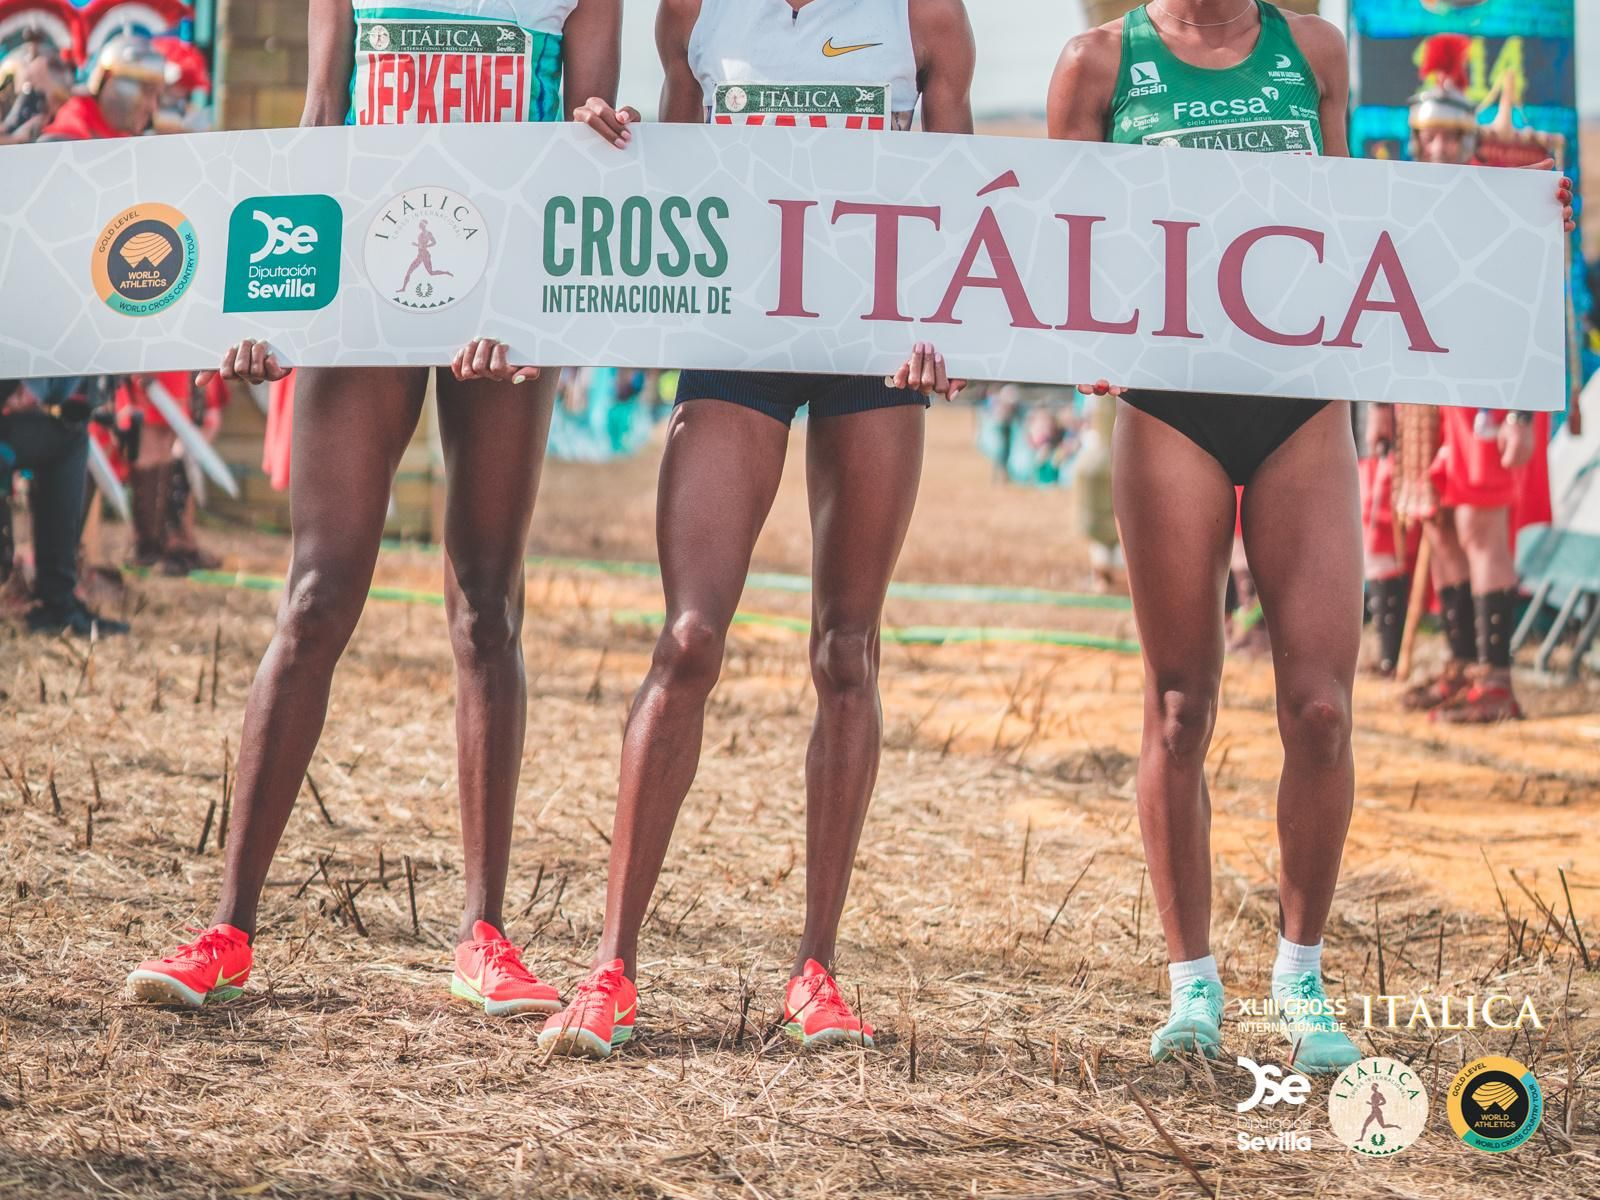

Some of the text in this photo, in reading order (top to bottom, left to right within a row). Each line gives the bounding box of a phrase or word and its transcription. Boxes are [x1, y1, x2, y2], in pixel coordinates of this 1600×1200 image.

[400, 25, 483, 47] ITÁLICA
[758, 87, 842, 108] ITÁLICA
[1131, 83, 1168, 97] asán
[1192, 131, 1274, 151] ITÁLICA
[374, 193, 479, 241] ITÁLICA
[98, 210, 140, 253] GOLD LEVEL
[542, 195, 730, 278] CROSS
[248, 264, 317, 280] Diputación
[765, 169, 1450, 354] ITÁLICA
[118, 232, 195, 313] WORLD CROSS COUNTRY TOUR
[128, 270, 160, 280] WORLD
[119, 278, 167, 289] ATHLETICS
[247, 278, 316, 299] Sevilla
[542, 285, 732, 315] INTERNACIONAL DE
